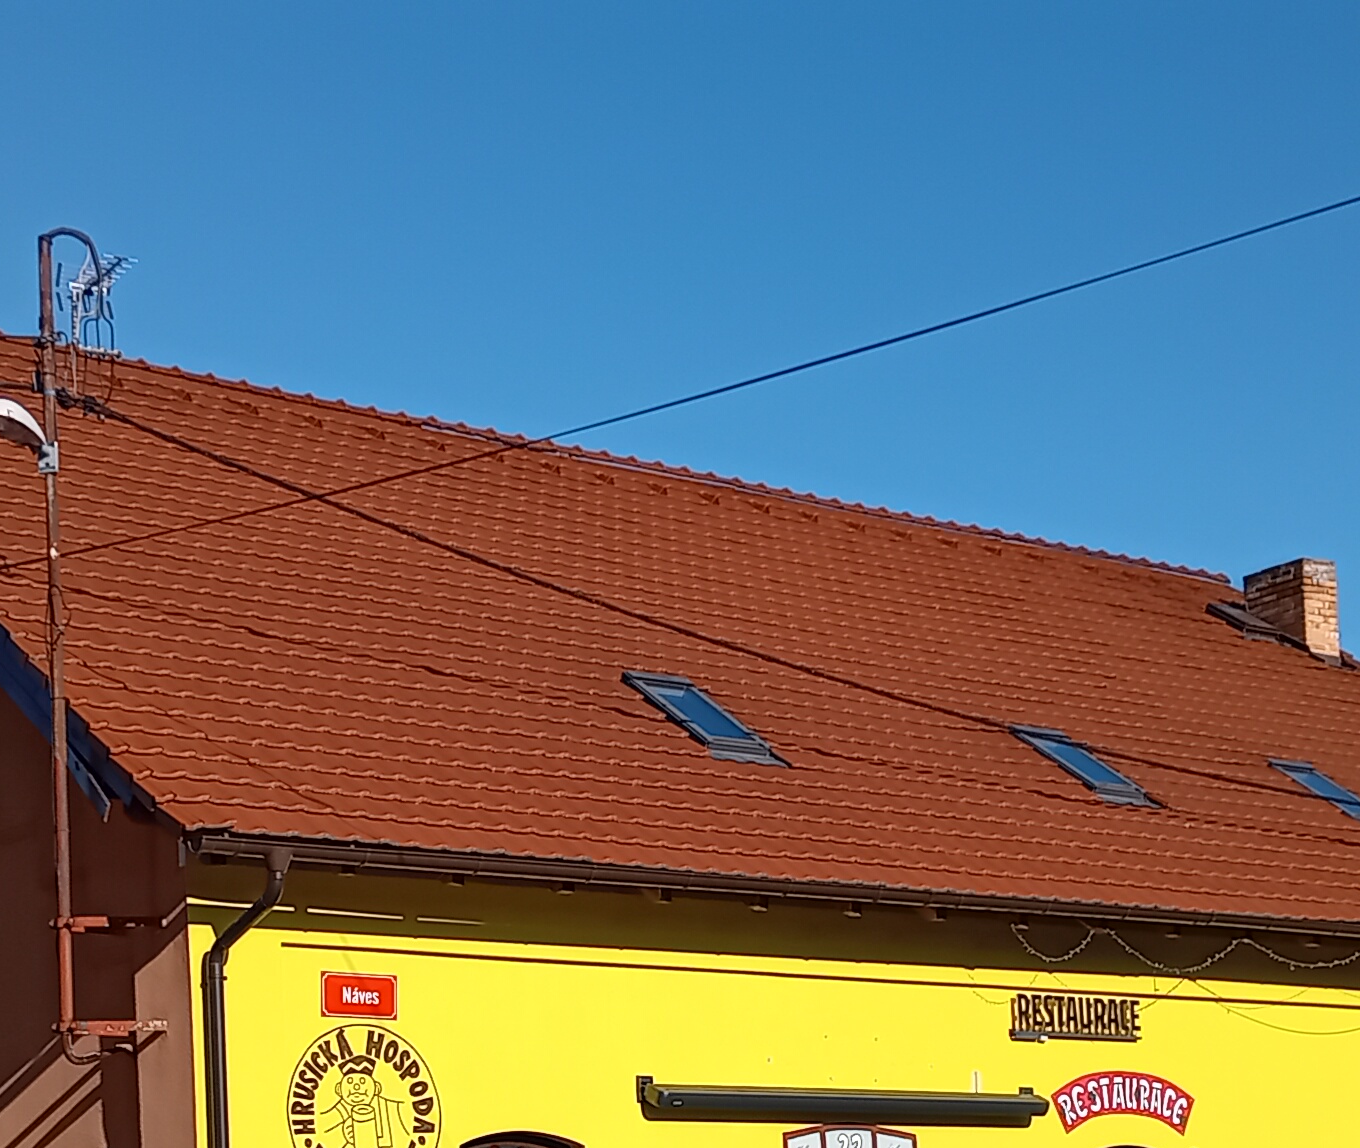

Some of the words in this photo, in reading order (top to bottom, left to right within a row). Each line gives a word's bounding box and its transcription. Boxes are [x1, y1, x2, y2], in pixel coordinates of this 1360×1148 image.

[342, 986, 380, 1005] Náves
[1016, 994, 1141, 1036] RESTAURACE
[291, 1028, 354, 1135] HRUSICKÁ
[365, 1029, 436, 1134] HOSPODA
[1057, 1076, 1188, 1126] RESTAURACE
